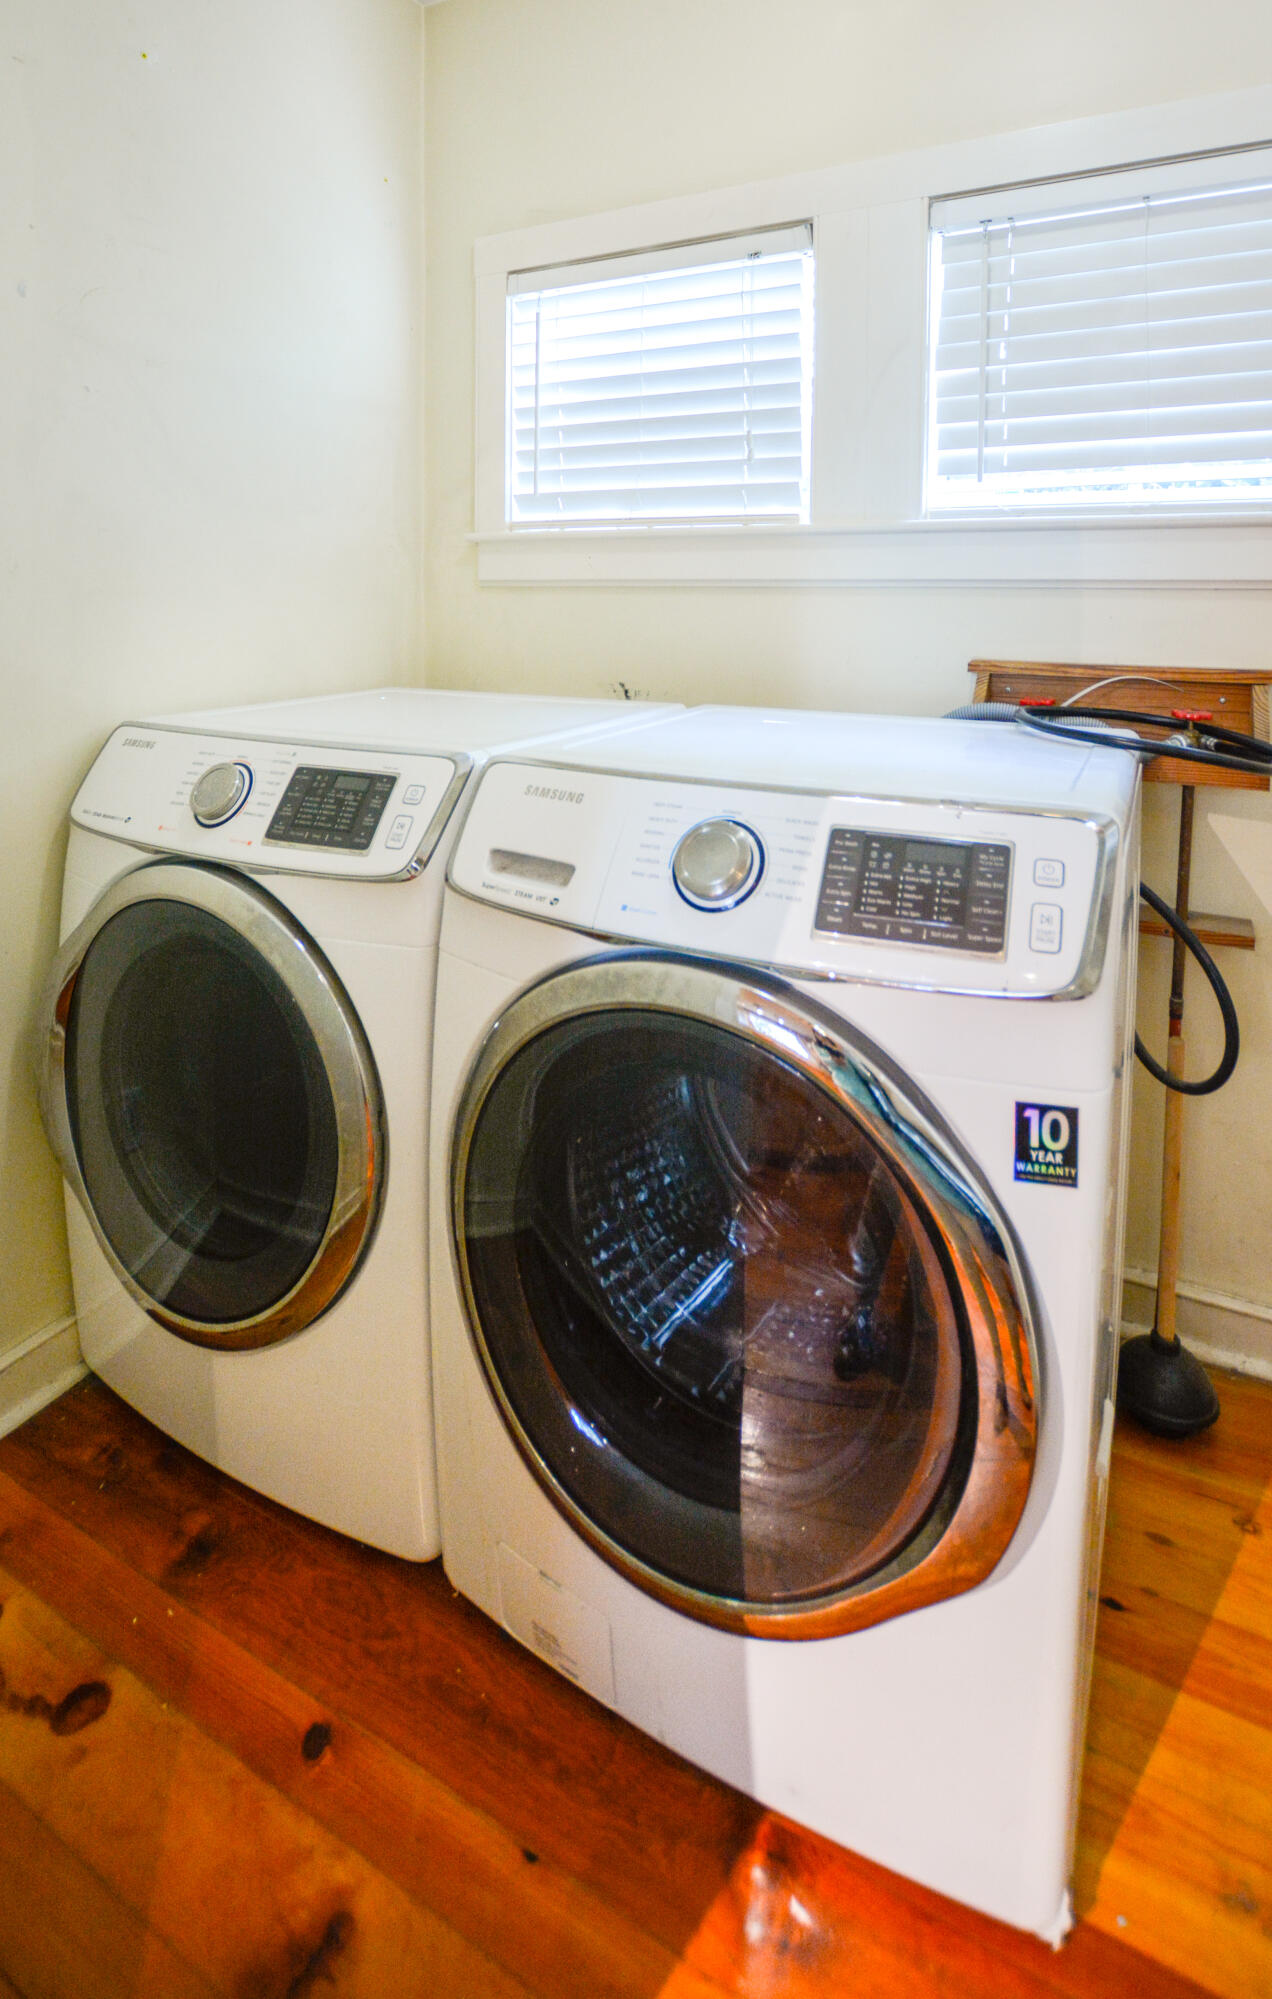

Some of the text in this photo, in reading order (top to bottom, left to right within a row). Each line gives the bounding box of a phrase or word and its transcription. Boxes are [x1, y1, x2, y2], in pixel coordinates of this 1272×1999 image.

[524, 783, 585, 804] SAMSUNG
[1023, 1107, 1070, 1151] 10
[1030, 1149, 1064, 1165] YEAR
[1016, 1160, 1077, 1178] WARRANTY
